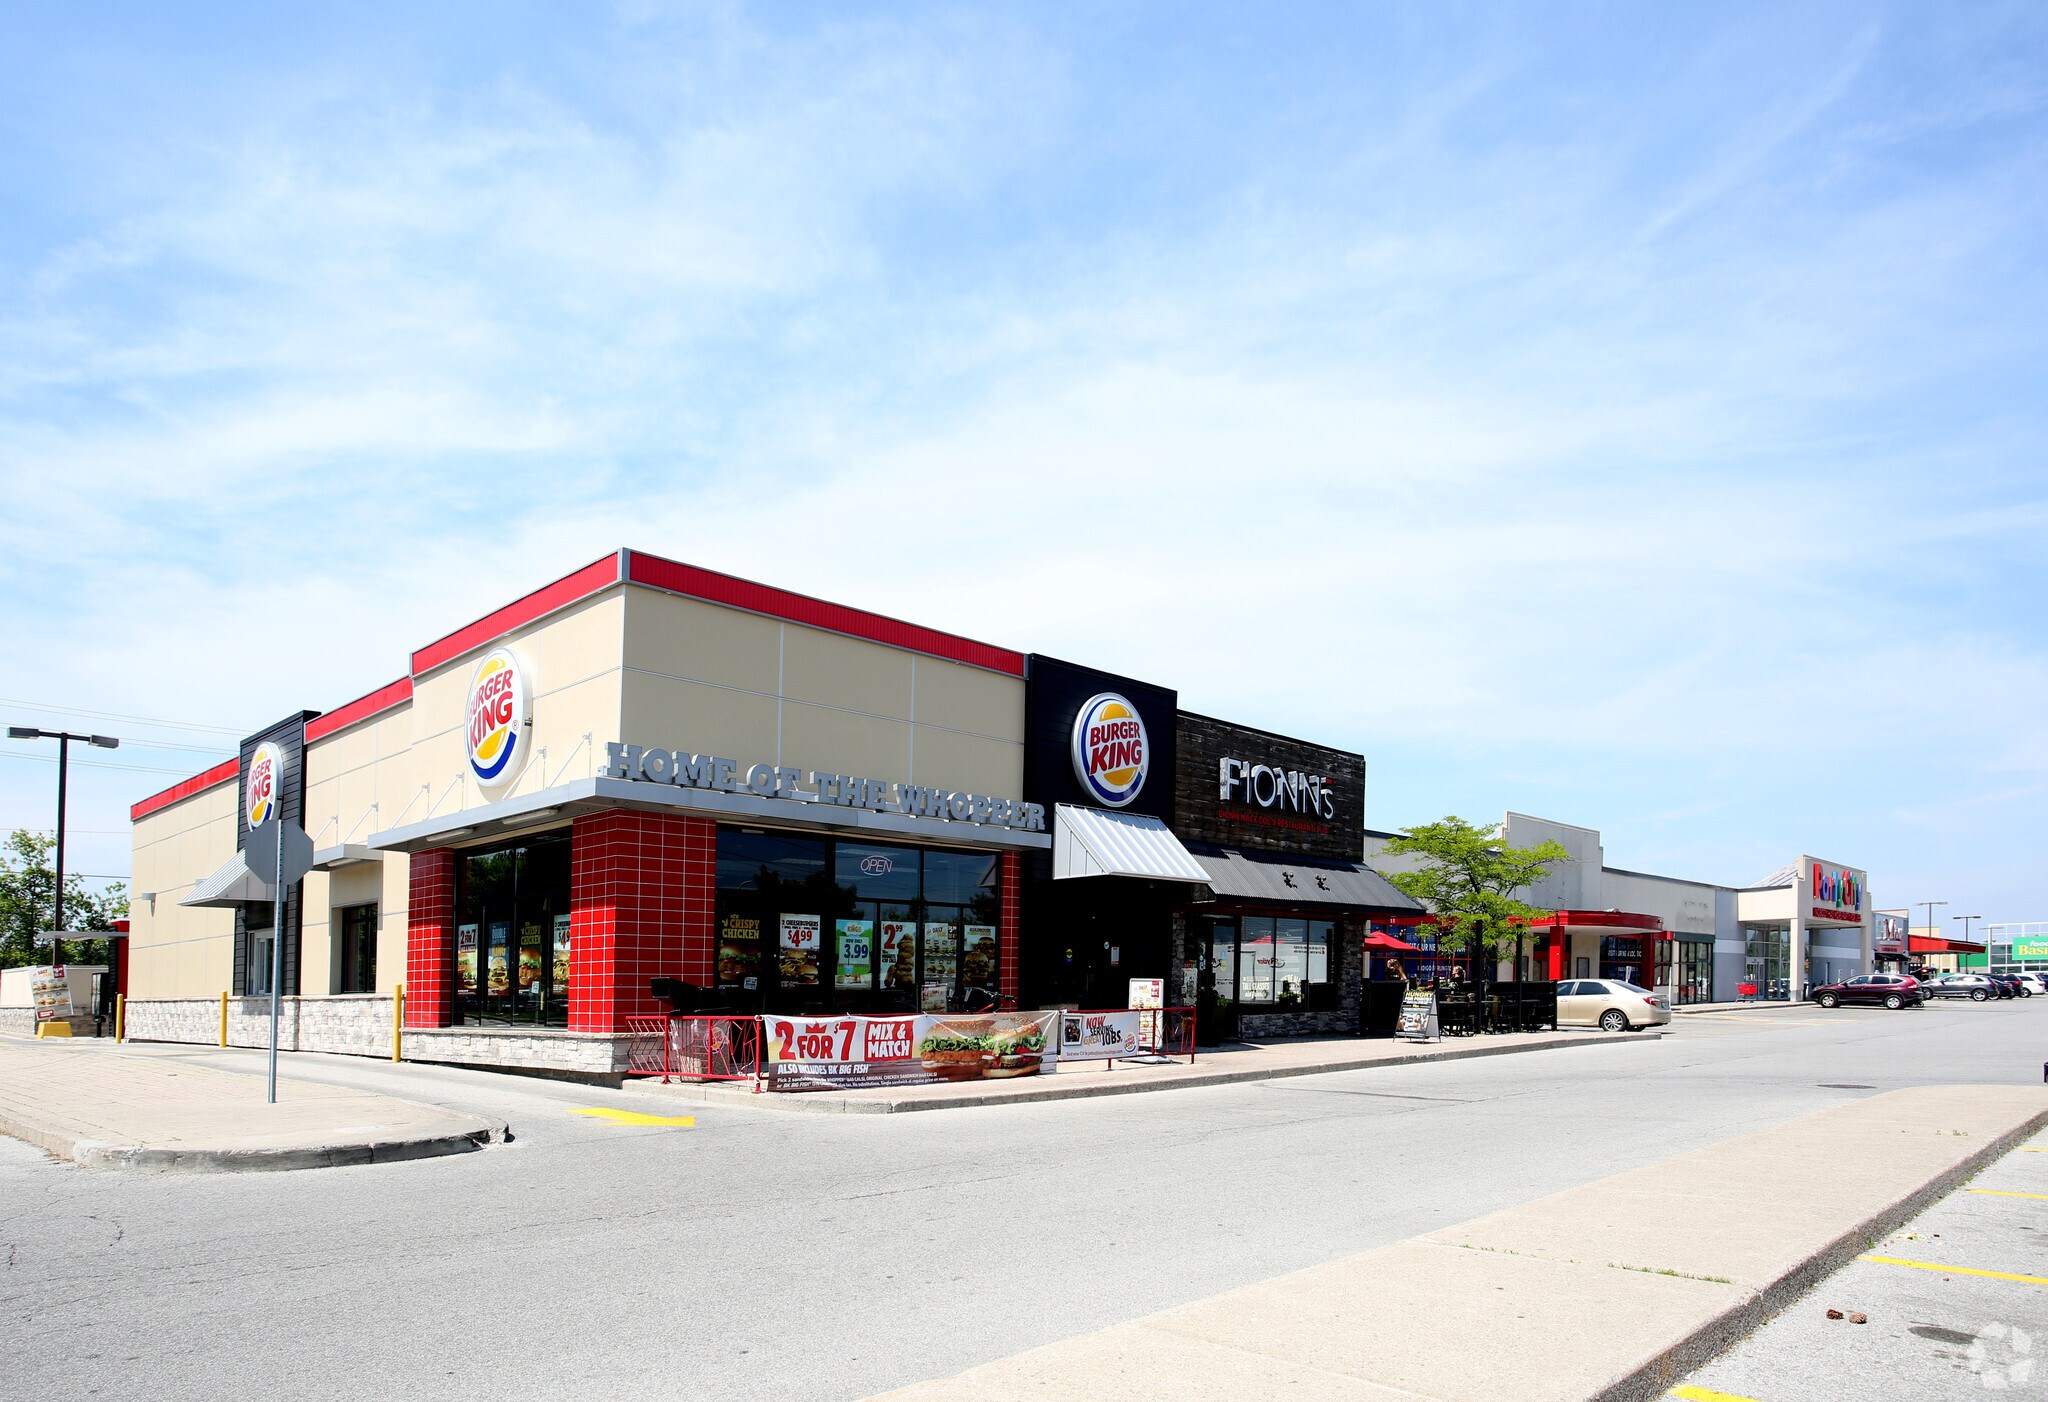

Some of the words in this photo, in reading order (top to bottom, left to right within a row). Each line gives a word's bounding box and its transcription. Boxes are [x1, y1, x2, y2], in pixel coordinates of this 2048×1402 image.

[470, 669, 513, 718] BURGER
[470, 691, 513, 757] KING
[1090, 721, 1141, 747] BURGER
[1090, 739, 1142, 775] KING
[249, 774, 271, 812] ING
[605, 742, 736, 791] HOME
[746, 763, 801, 799] OF
[810, 771, 886, 812] THE
[893, 783, 1045, 830] WHOPPER
[861, 859, 892, 872] OPEN
[1813, 863, 1842, 908] Party
[1842, 868, 1862, 911] City
[730, 919, 760, 930] CRISPY
[722, 929, 759, 939] CHICKEN
[844, 944, 868, 959] 3.99
[868, 1024, 895, 1040] MIX
[897, 1023, 906, 1039] &
[1086, 1016, 1106, 1030] NOW
[1090, 1024, 1114, 1036] SERVING
[775, 1021, 796, 1060] 2
[797, 1035, 833, 1059] FOR
[1102, 1030, 1123, 1046] JOBS.
[868, 1040, 910, 1058] MATCH
[777, 1064, 798, 1075] ALSO
[828, 1064, 839, 1075] BK
[839, 1065, 852, 1075] BIG
[853, 1064, 869, 1075] FISH
